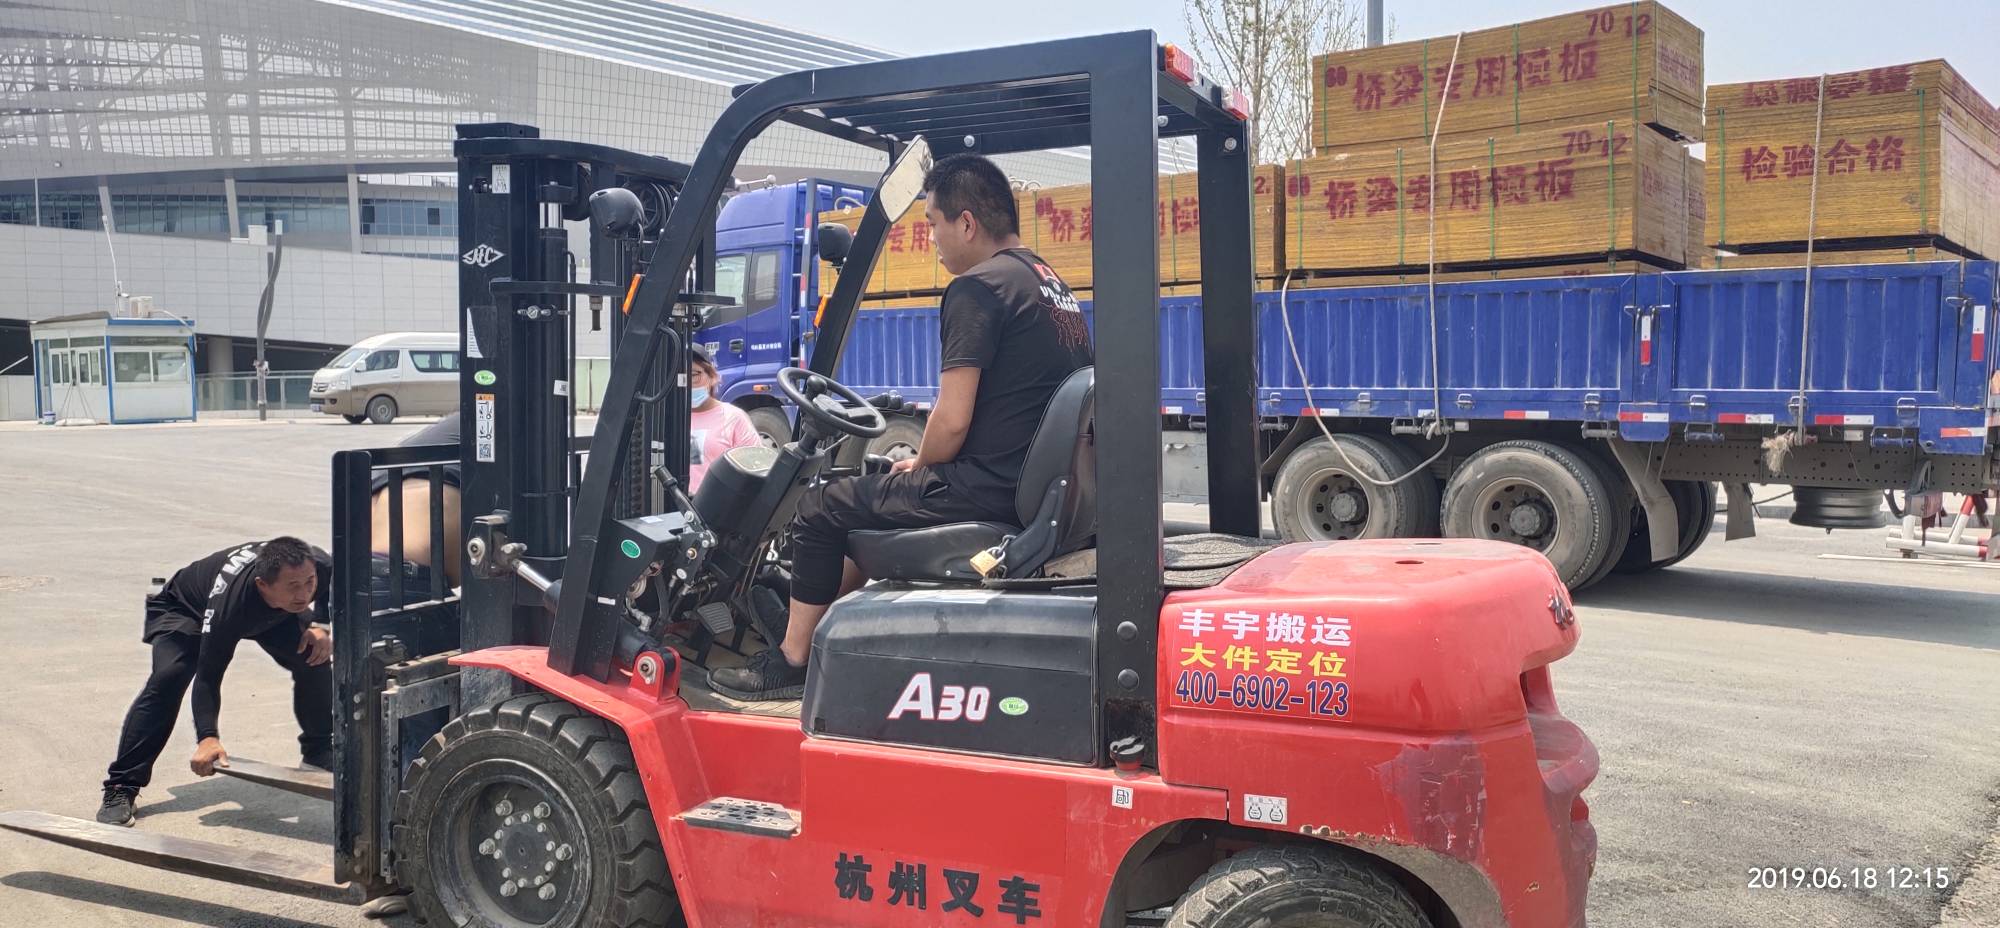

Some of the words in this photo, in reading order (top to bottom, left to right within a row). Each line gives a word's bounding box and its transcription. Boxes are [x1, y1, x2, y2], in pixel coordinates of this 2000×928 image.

[1585, 13, 1615, 37] 70
[1562, 130, 1592, 156] 70
[1742, 135, 1905, 182] 检验合格
[1178, 608, 1352, 647] 丰宇搬运
[1180, 642, 1347, 678] 大件定位
[887, 672, 991, 722] A30
[1175, 670, 1349, 717] 400-6902-123
[834, 852, 1042, 924] 杭州叉车
